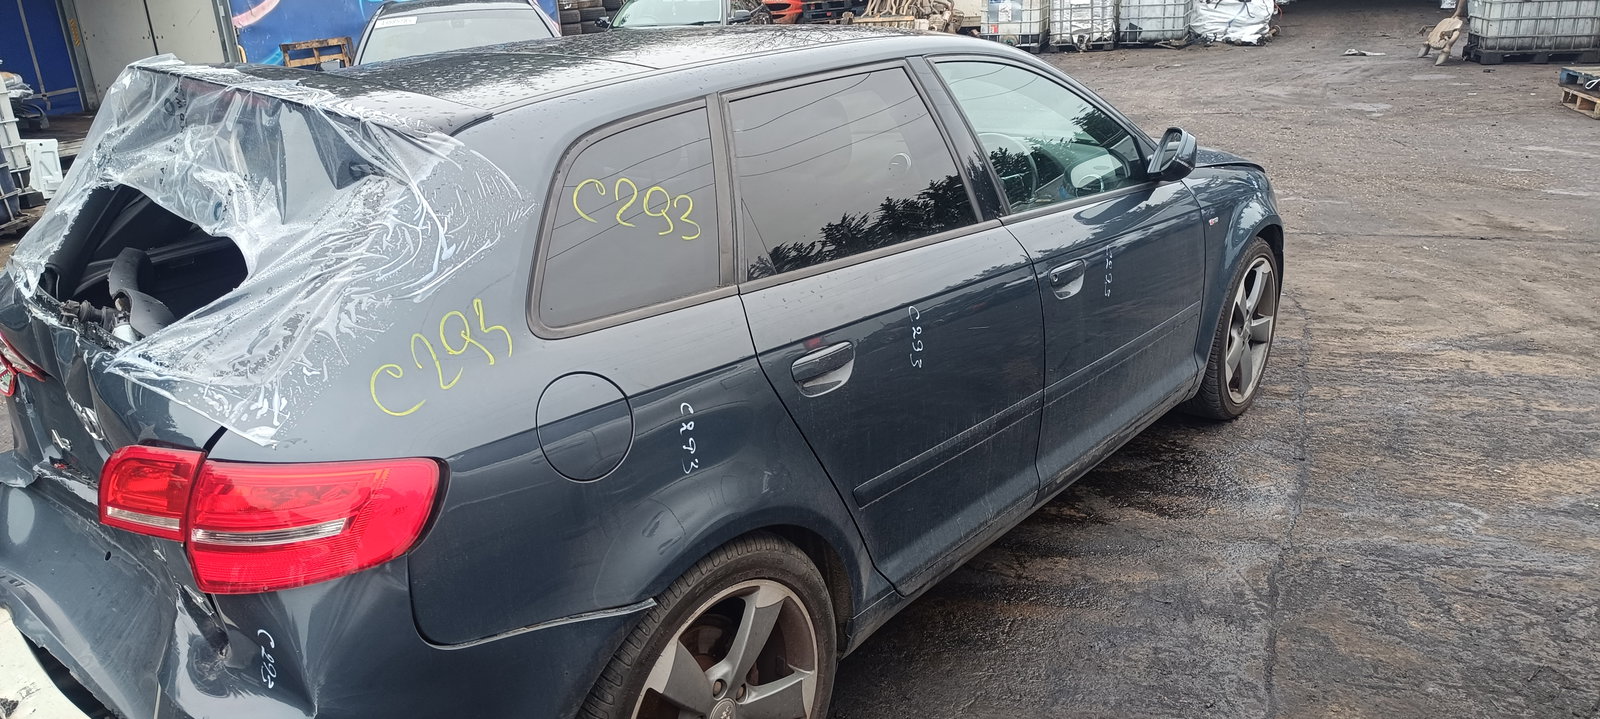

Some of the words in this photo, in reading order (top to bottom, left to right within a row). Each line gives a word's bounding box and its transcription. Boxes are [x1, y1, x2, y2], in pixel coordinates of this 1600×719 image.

[573, 177, 701, 241] C293
[370, 298, 513, 416] C293
[908, 305, 924, 369] C293
[680, 402, 699, 474] C293
[257, 629, 277, 689] C293
